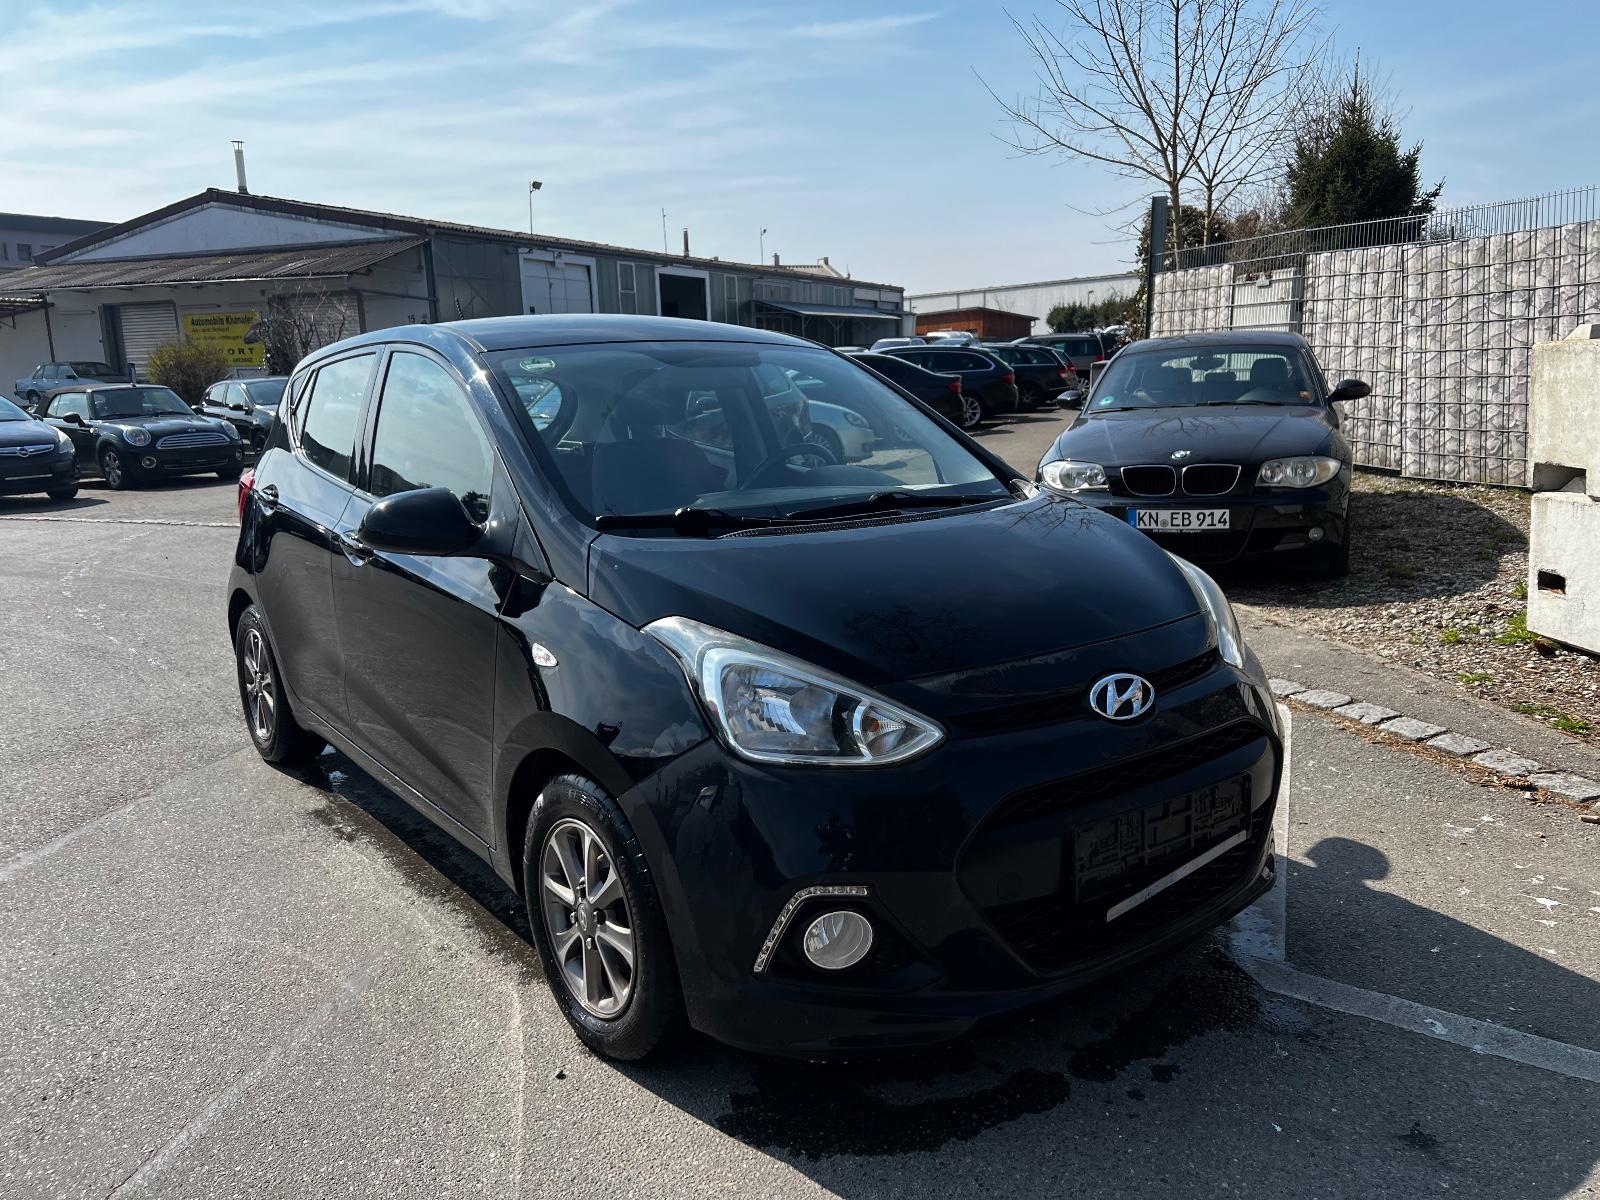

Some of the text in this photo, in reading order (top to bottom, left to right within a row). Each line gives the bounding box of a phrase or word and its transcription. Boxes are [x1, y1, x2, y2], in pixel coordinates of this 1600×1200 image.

[1137, 511, 1228, 527] KN EB 914
